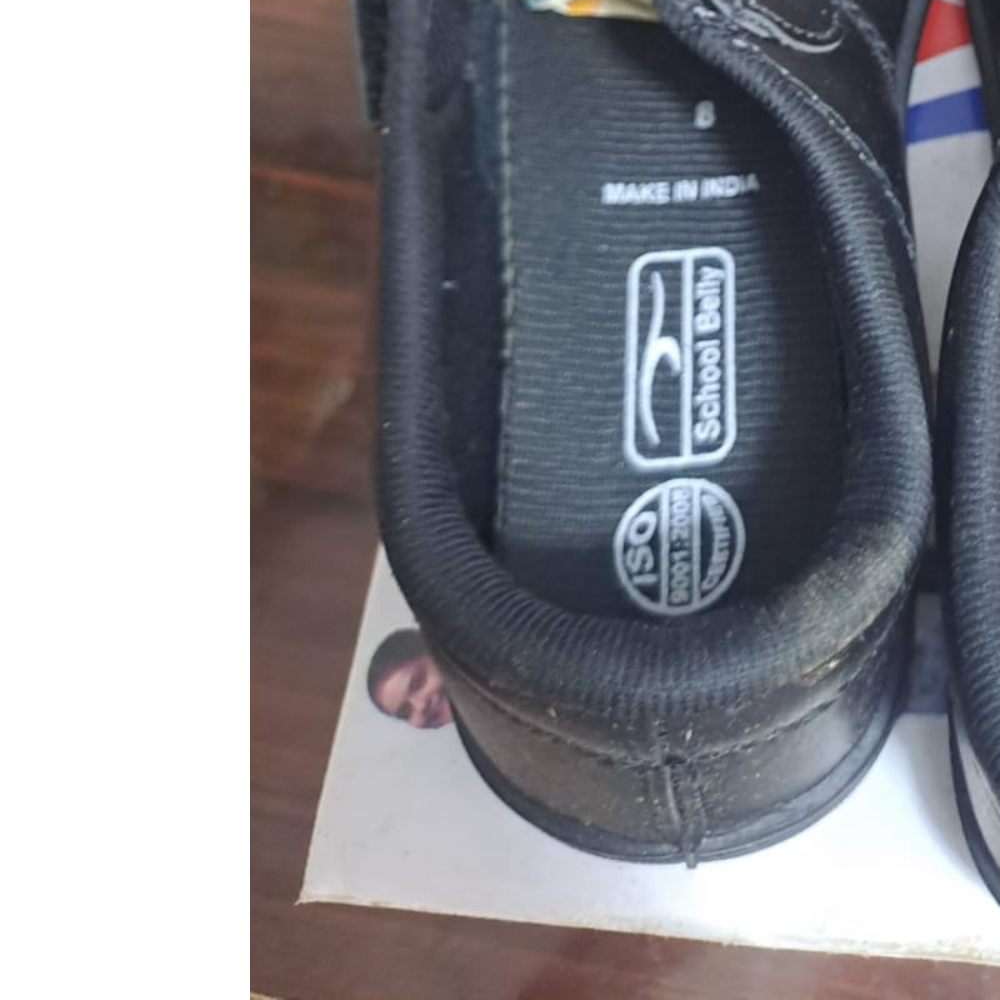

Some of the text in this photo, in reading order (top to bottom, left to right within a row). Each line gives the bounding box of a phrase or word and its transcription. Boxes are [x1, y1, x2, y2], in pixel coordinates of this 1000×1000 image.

[602, 174, 760, 204] MAKE IN INDIA
[694, 266, 725, 444] School Belly
[626, 511, 658, 586] ISO
